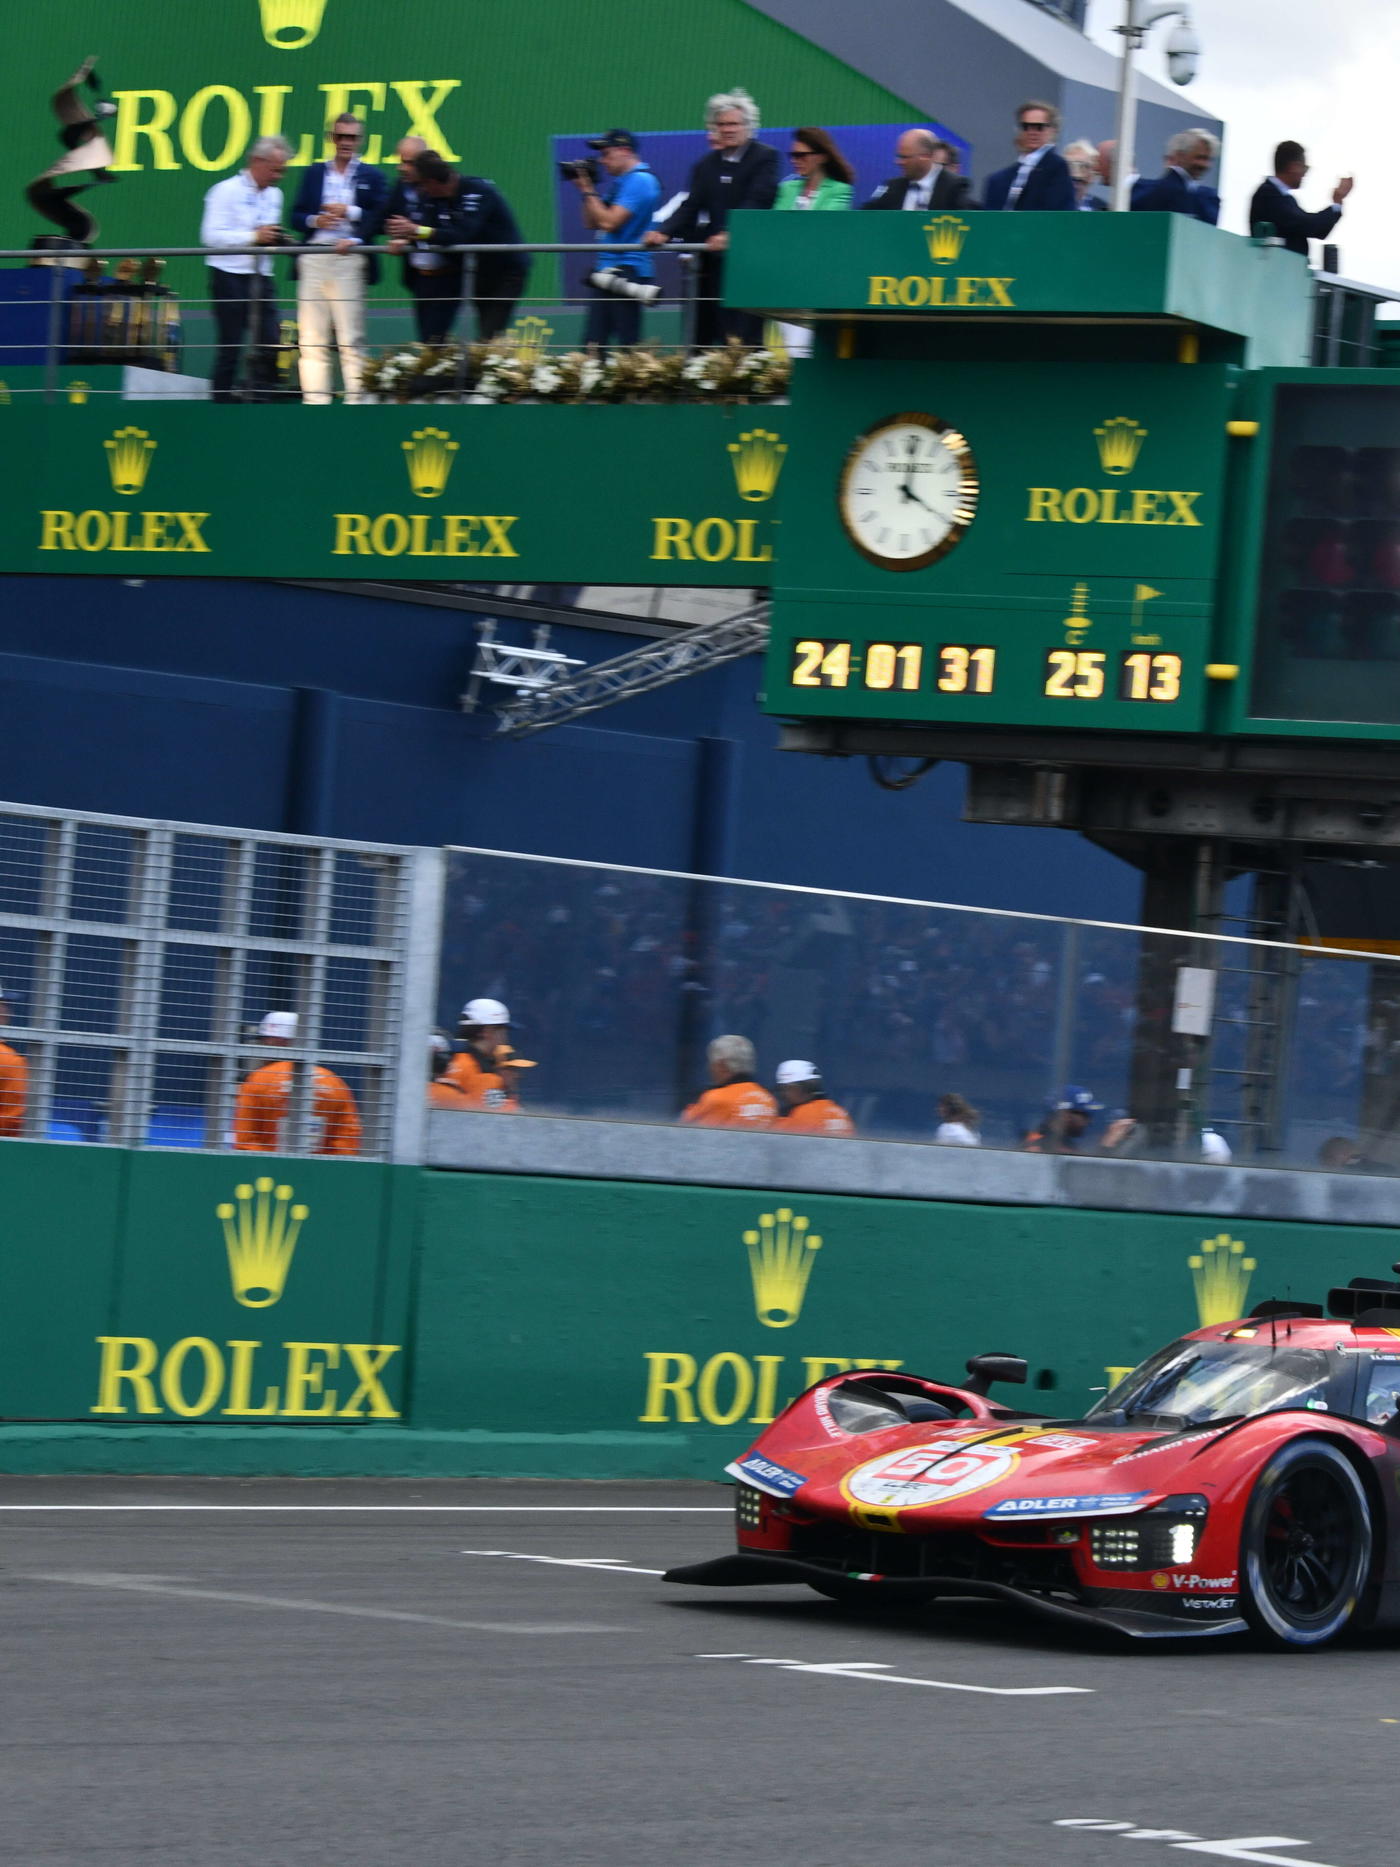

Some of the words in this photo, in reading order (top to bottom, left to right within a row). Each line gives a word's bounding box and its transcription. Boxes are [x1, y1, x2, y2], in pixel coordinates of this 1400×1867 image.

[106, 80, 462, 171] ROLEX
[867, 275, 1015, 307] ROLEX
[1026, 487, 1202, 526] ROLEX
[40, 510, 211, 553] ROLEX
[333, 513, 519, 558] ROLEX
[650, 517, 781, 562] ROL
[938, 648, 995, 693] 31
[1045, 651, 1106, 698] 25
[1124, 653, 1182, 700] 13
[90, 1336, 401, 1418] ROLEX
[638, 1352, 904, 1426] ROL
[748, 1458, 783, 1480] ADLER
[885, 1450, 981, 1482] 50
[996, 1498, 1076, 1511] ADLER
[1172, 1573, 1236, 1588] V-Power
